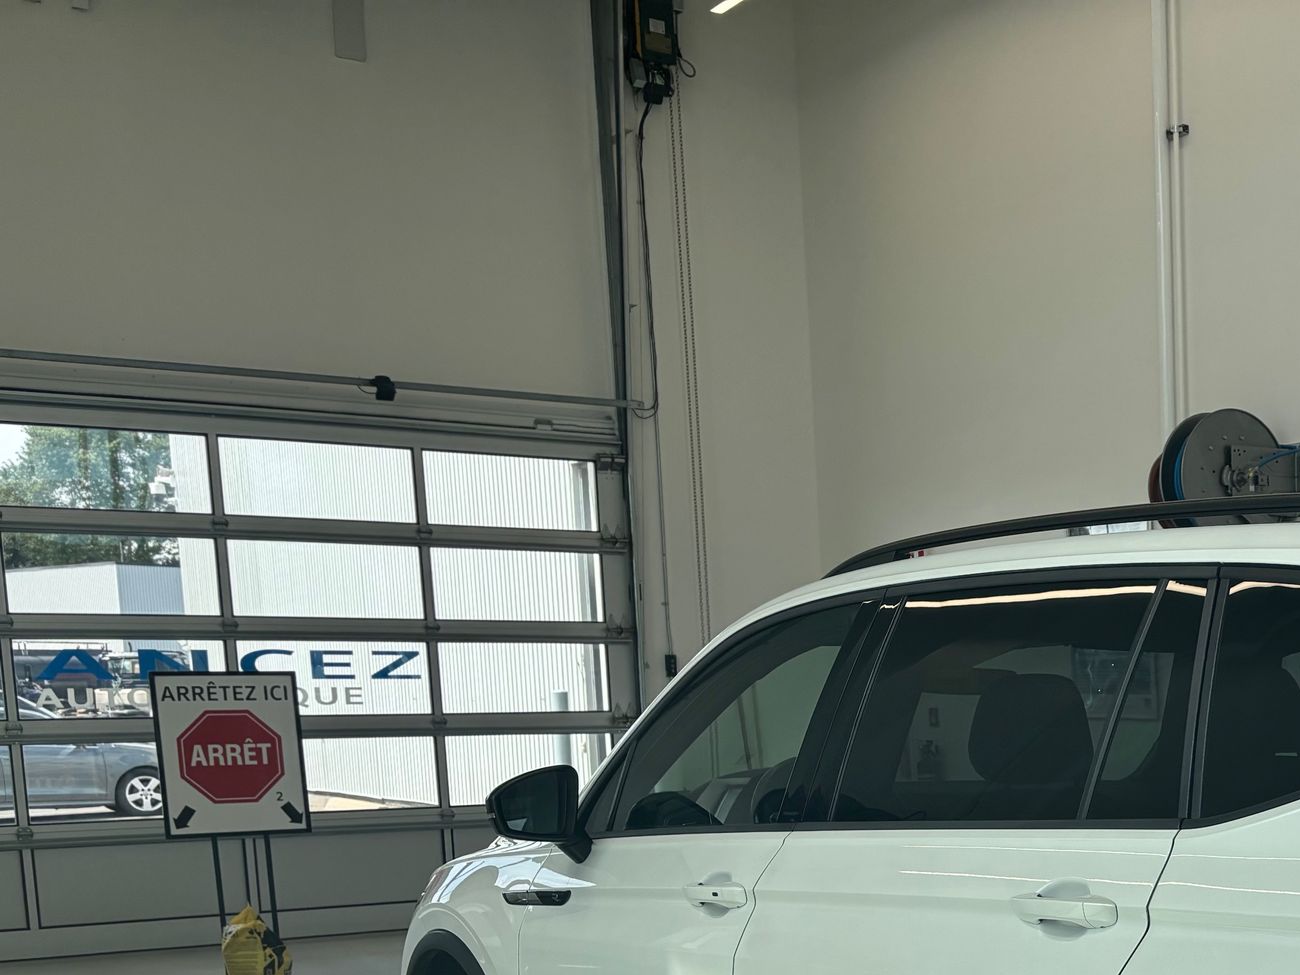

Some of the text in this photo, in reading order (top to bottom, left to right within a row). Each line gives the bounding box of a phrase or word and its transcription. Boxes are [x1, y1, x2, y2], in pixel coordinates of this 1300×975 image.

[161, 681, 288, 702] ARRÊTEZ ICI
[190, 738, 271, 767] ARRÊT
[276, 792, 284, 801] 2
